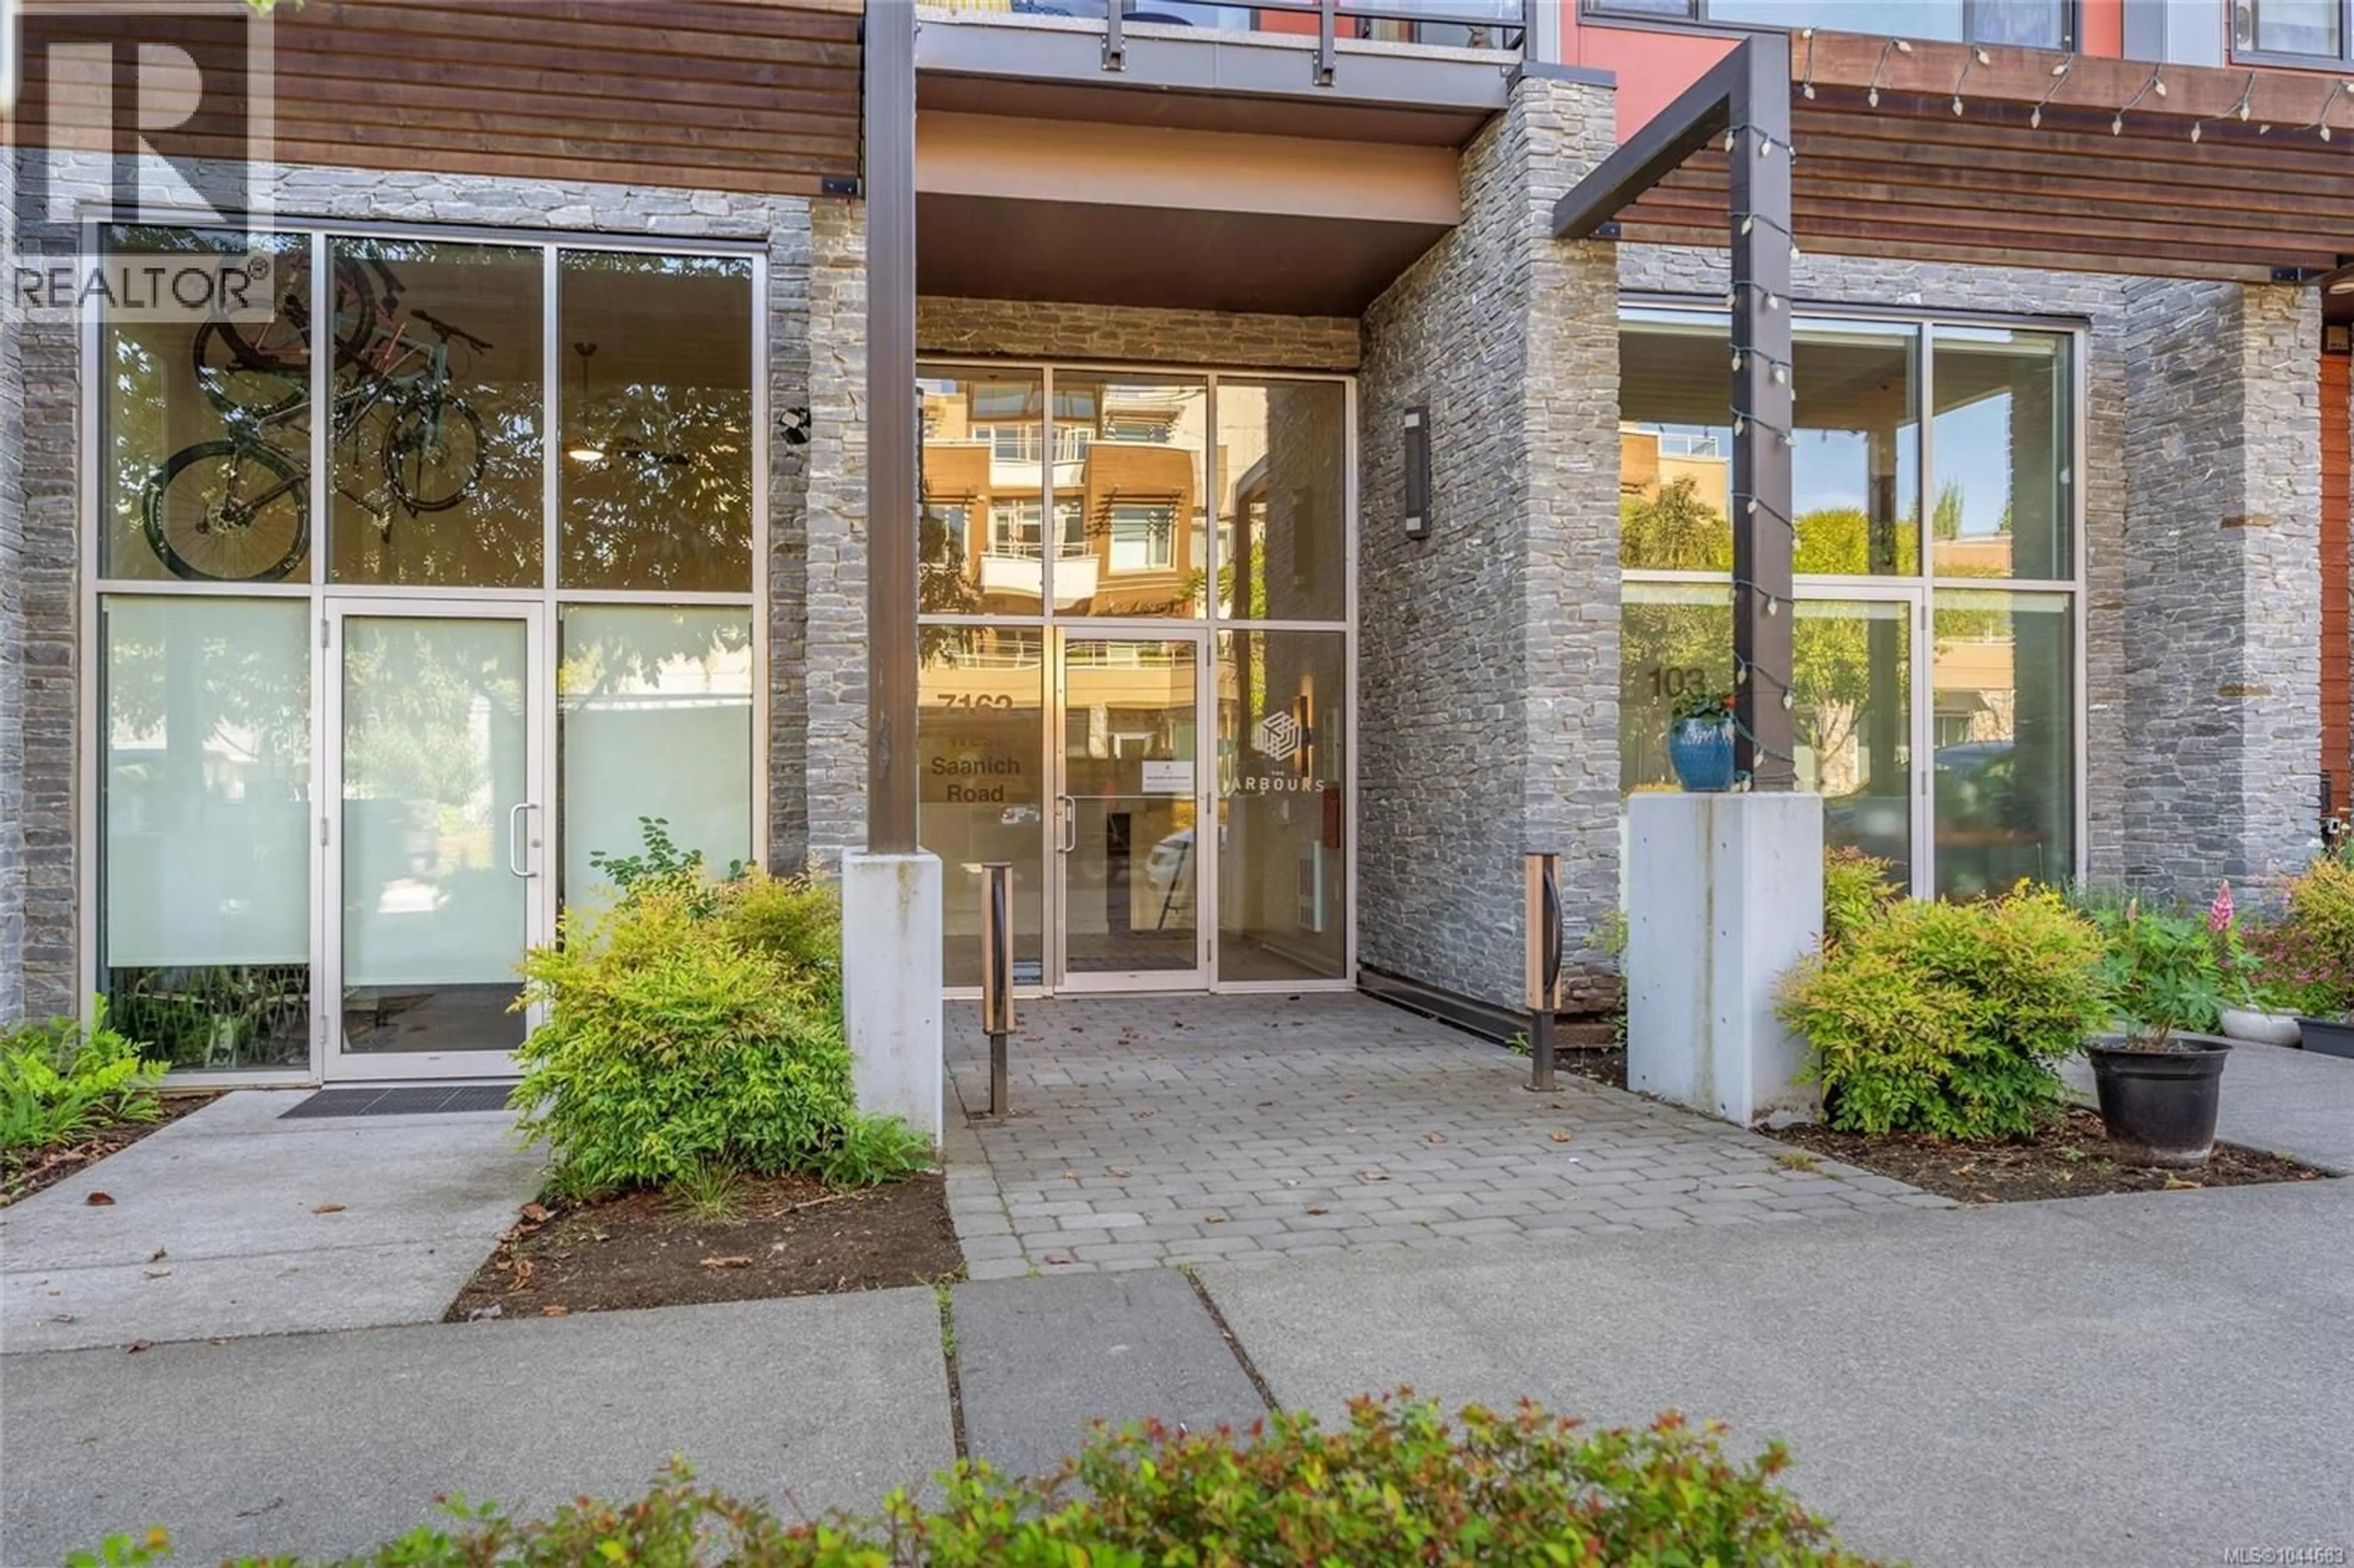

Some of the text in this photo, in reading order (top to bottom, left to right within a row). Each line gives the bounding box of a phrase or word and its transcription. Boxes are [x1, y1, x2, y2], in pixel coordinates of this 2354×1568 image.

[1647, 667, 1705, 698] 103
[931, 756, 1020, 775] Saanich
[947, 784, 1004, 802] Road
[1232, 776, 1325, 793] ARBOURS
